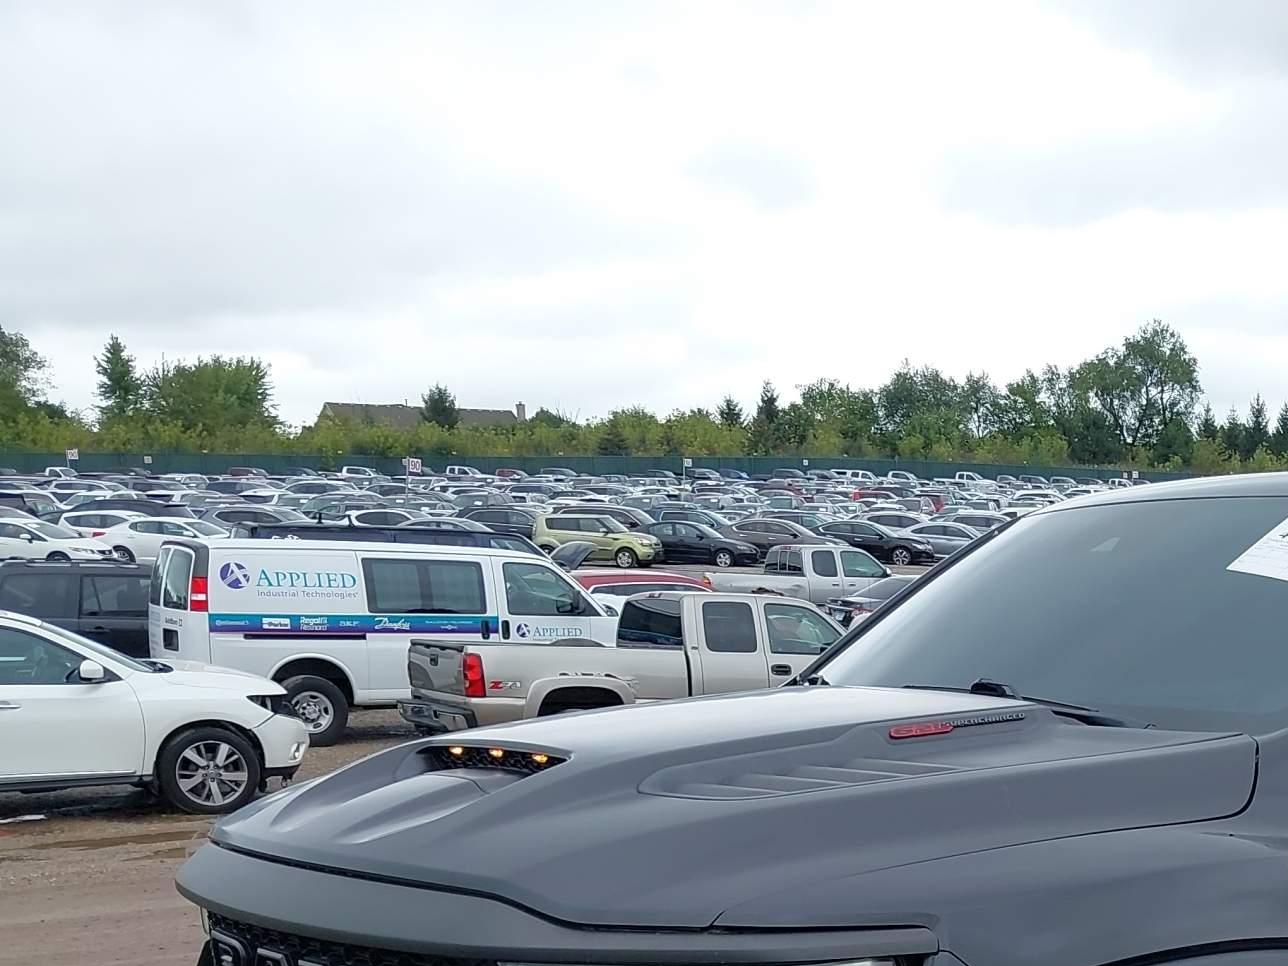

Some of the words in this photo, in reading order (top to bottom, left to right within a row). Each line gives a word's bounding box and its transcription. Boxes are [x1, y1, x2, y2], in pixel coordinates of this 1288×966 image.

[256, 568, 357, 589] APPLIED
[257, 590, 299, 598] Industrial
[302, 590, 357, 600] Technologies
[533, 626, 583, 637] APPLIED
